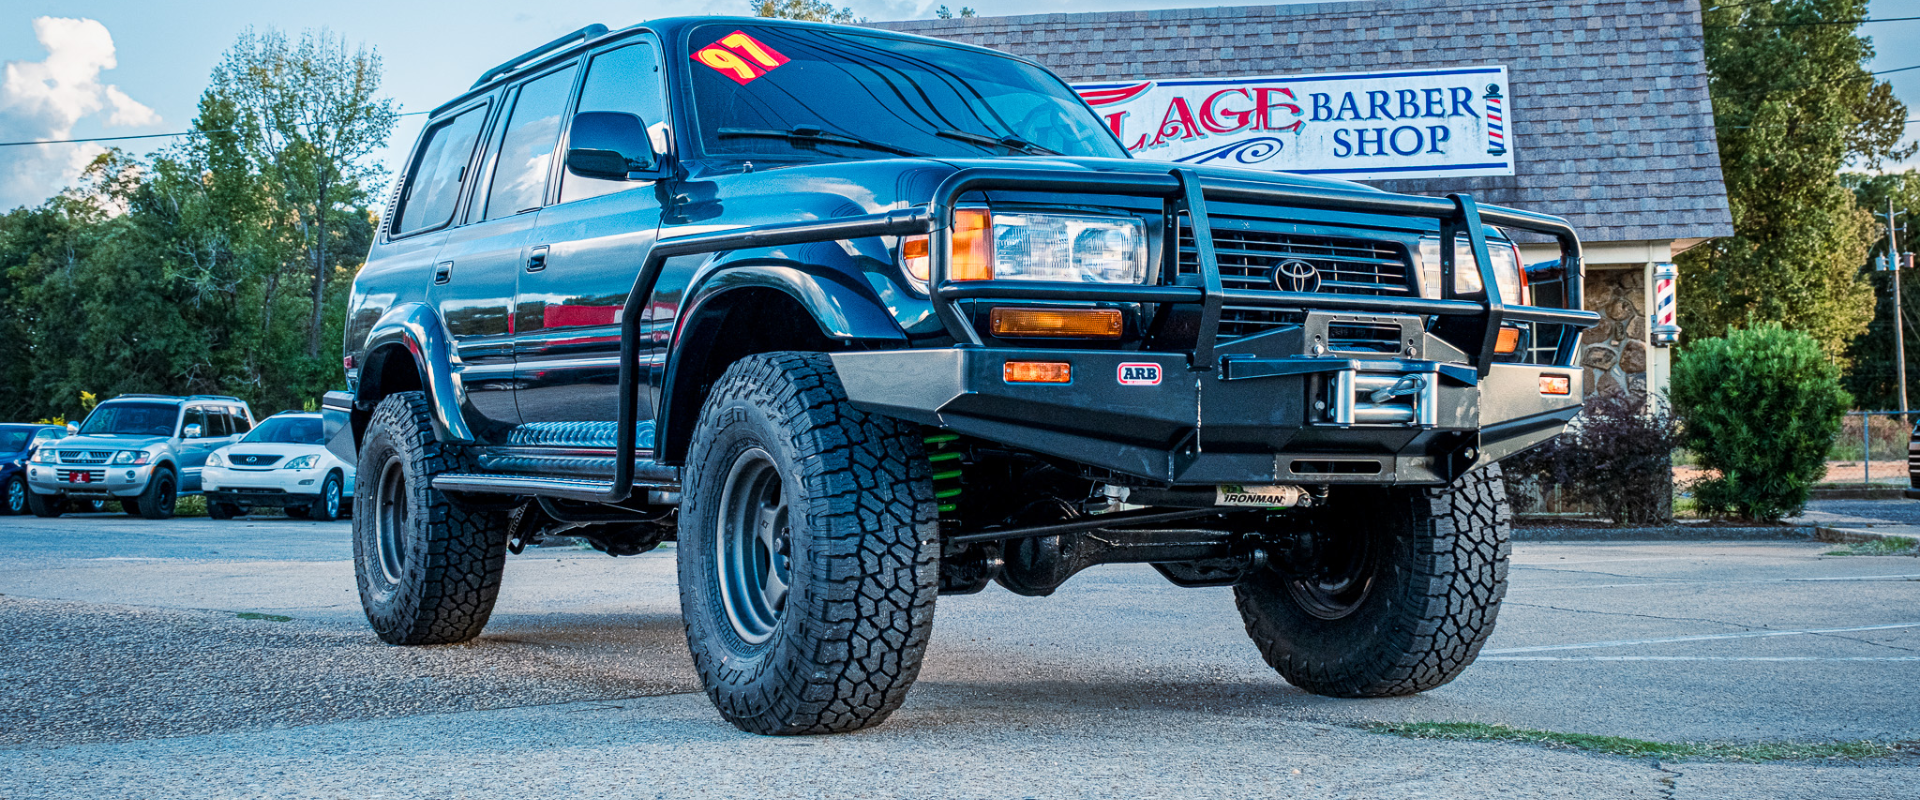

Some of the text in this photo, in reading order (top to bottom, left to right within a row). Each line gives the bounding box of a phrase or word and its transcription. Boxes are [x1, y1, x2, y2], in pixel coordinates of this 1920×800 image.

[698, 33, 779, 79] 97
[1103, 87, 1305, 151] LAGE
[1309, 86, 1481, 122] BARBER
[1333, 125, 1450, 158] SHOP
[1123, 367, 1157, 380] ARB
[1224, 494, 1283, 504] IRONMAN
